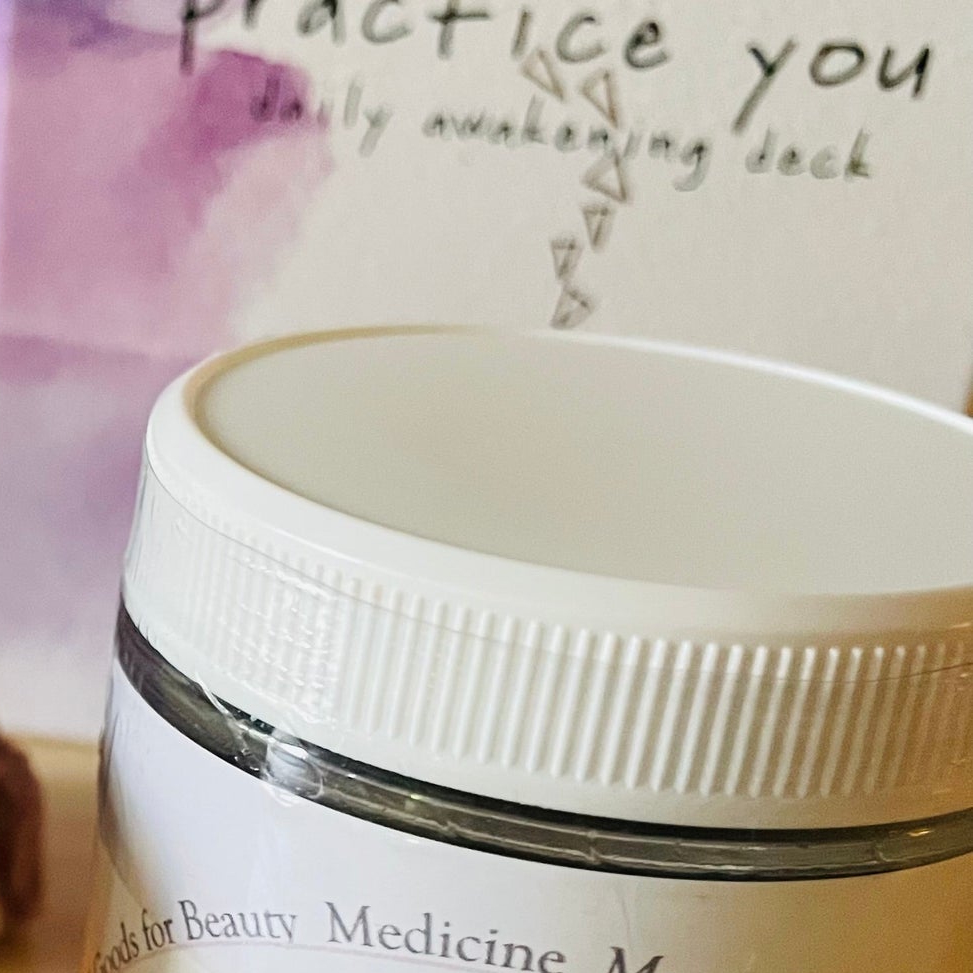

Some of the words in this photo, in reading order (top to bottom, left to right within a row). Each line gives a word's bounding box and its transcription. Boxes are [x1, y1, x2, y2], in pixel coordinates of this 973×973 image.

[179, 0, 670, 76] practice
[732, 37, 933, 136] you
[249, 72, 393, 157] daily
[422, 95, 713, 193] awakening
[745, 126, 873, 182] deck
[141, 908, 177, 951] for
[177, 898, 299, 944] Beauty
